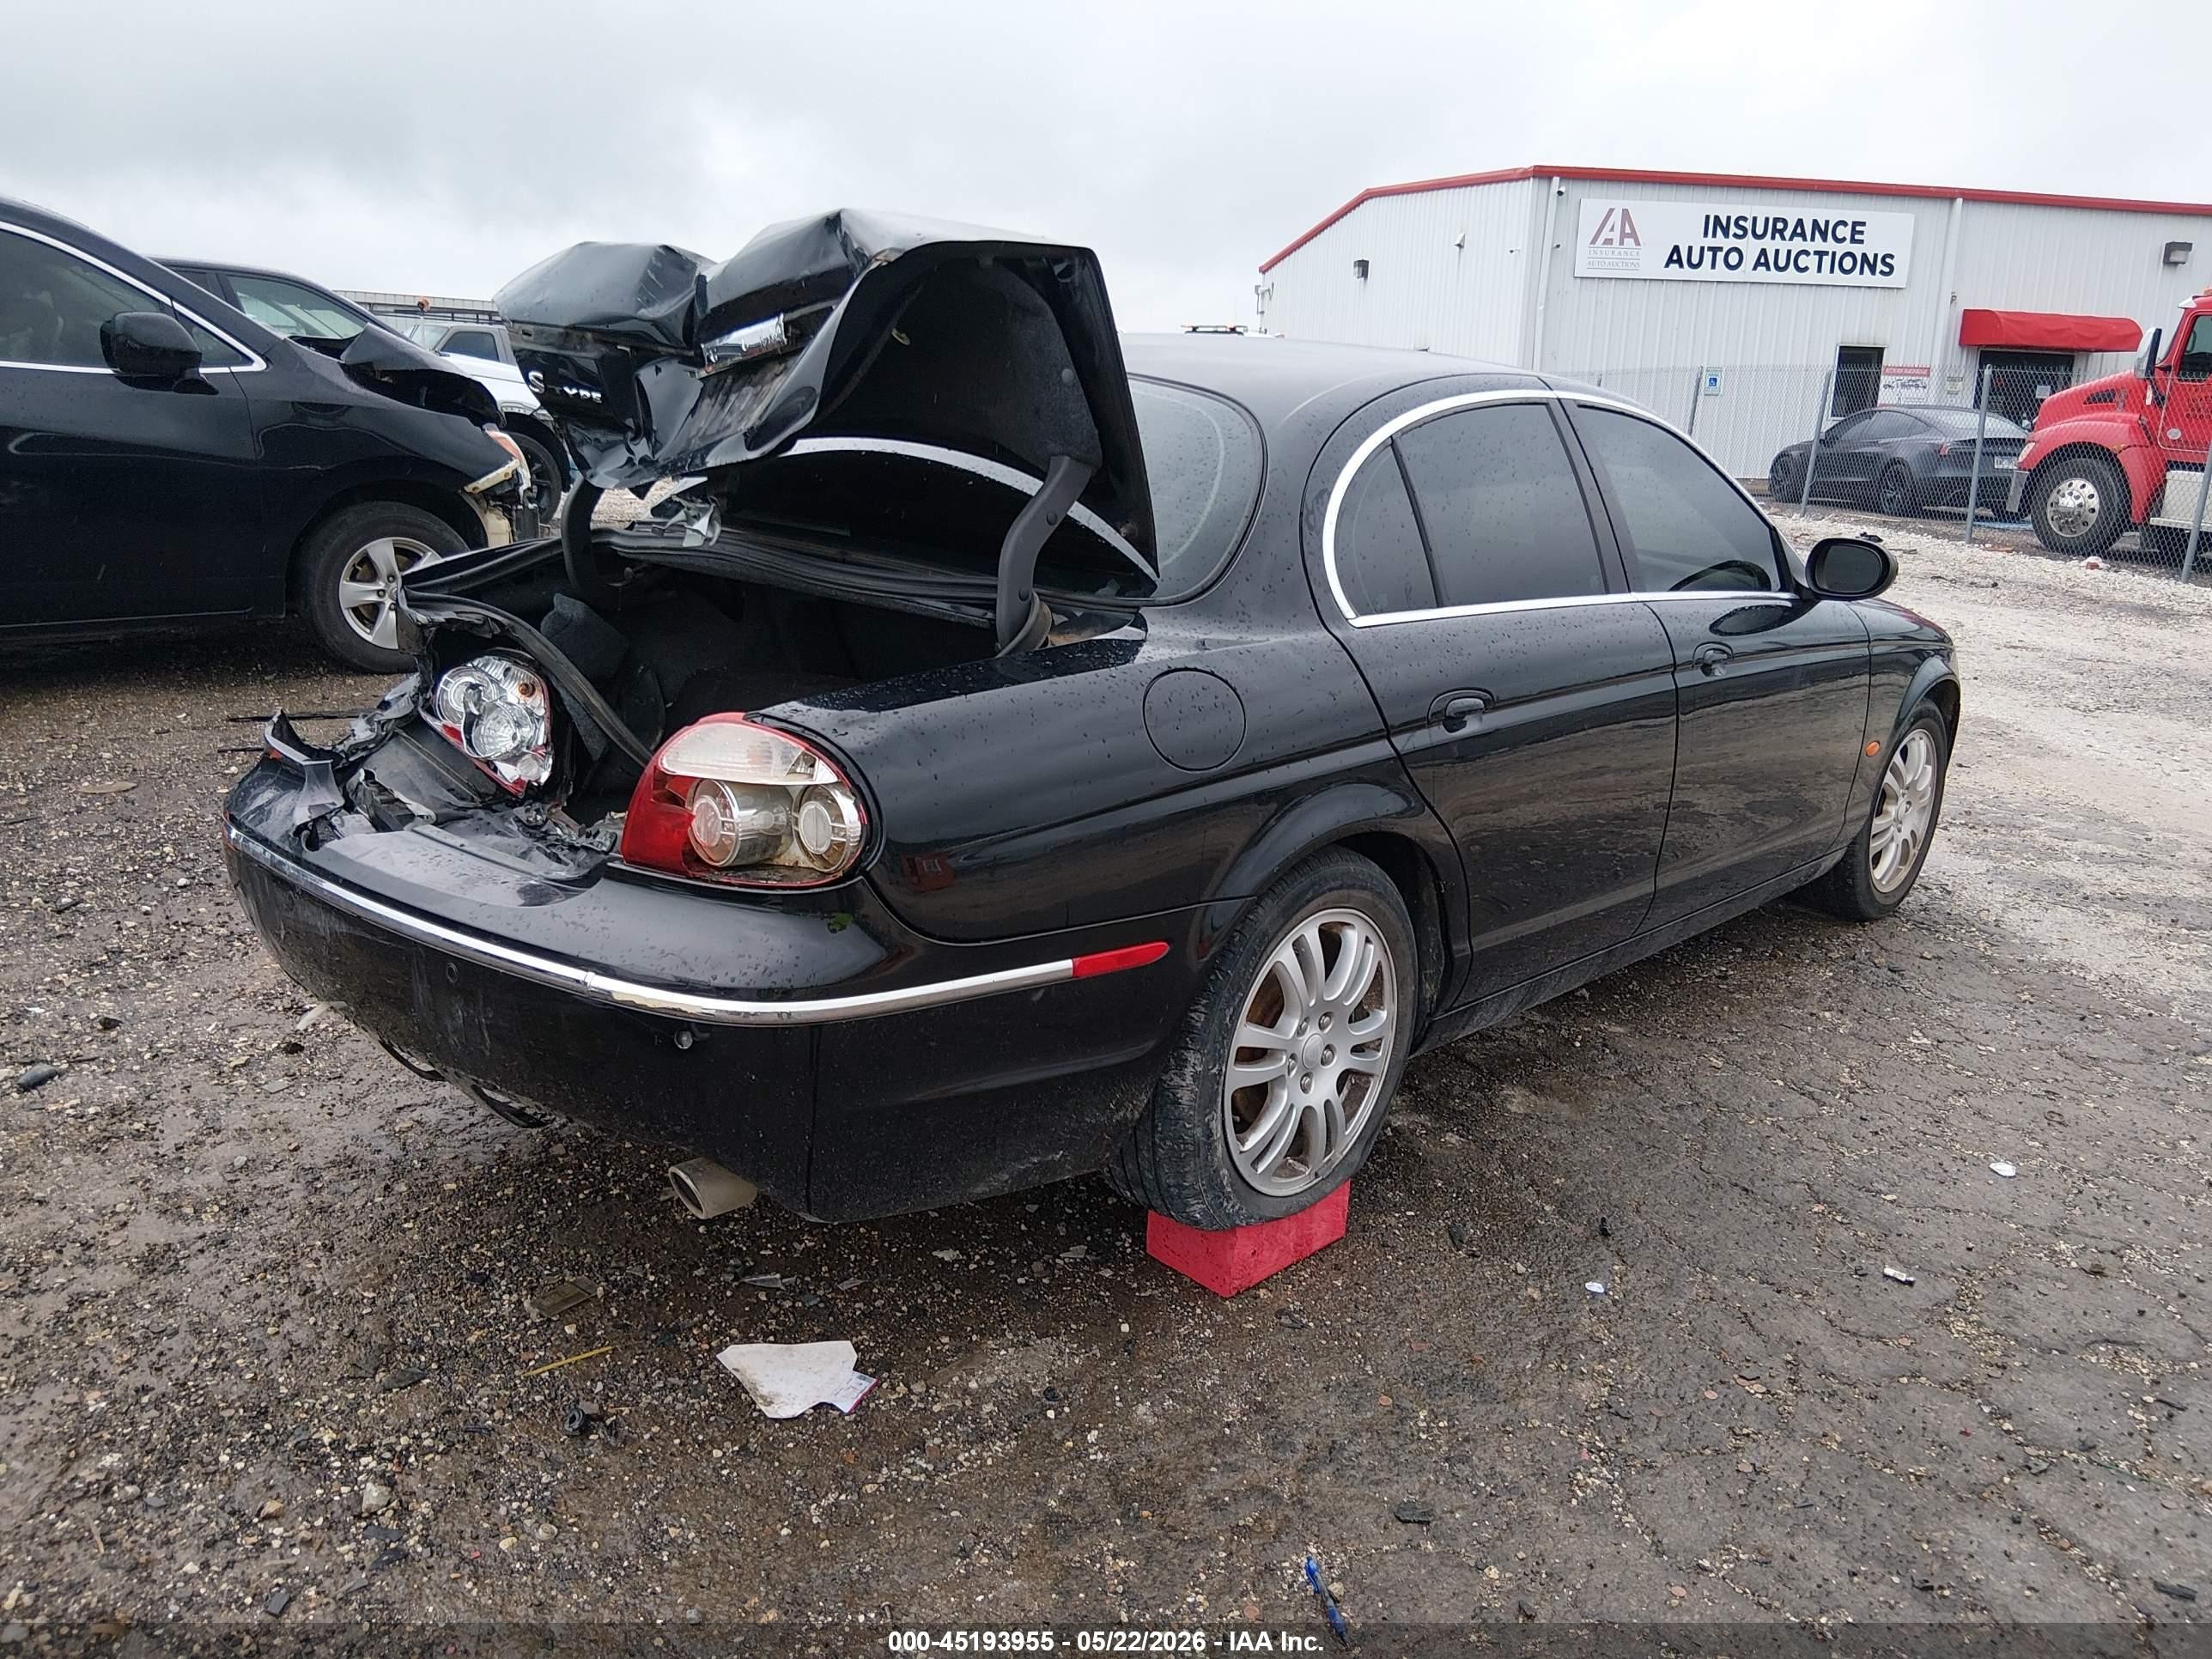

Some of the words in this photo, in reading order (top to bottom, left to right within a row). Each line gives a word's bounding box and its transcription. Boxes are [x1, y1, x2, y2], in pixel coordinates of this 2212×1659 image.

[1703, 215, 1867, 245] INSURANCE
[1664, 245, 1744, 271] AUTO
[1752, 247, 1896, 277] AUCTIONS
